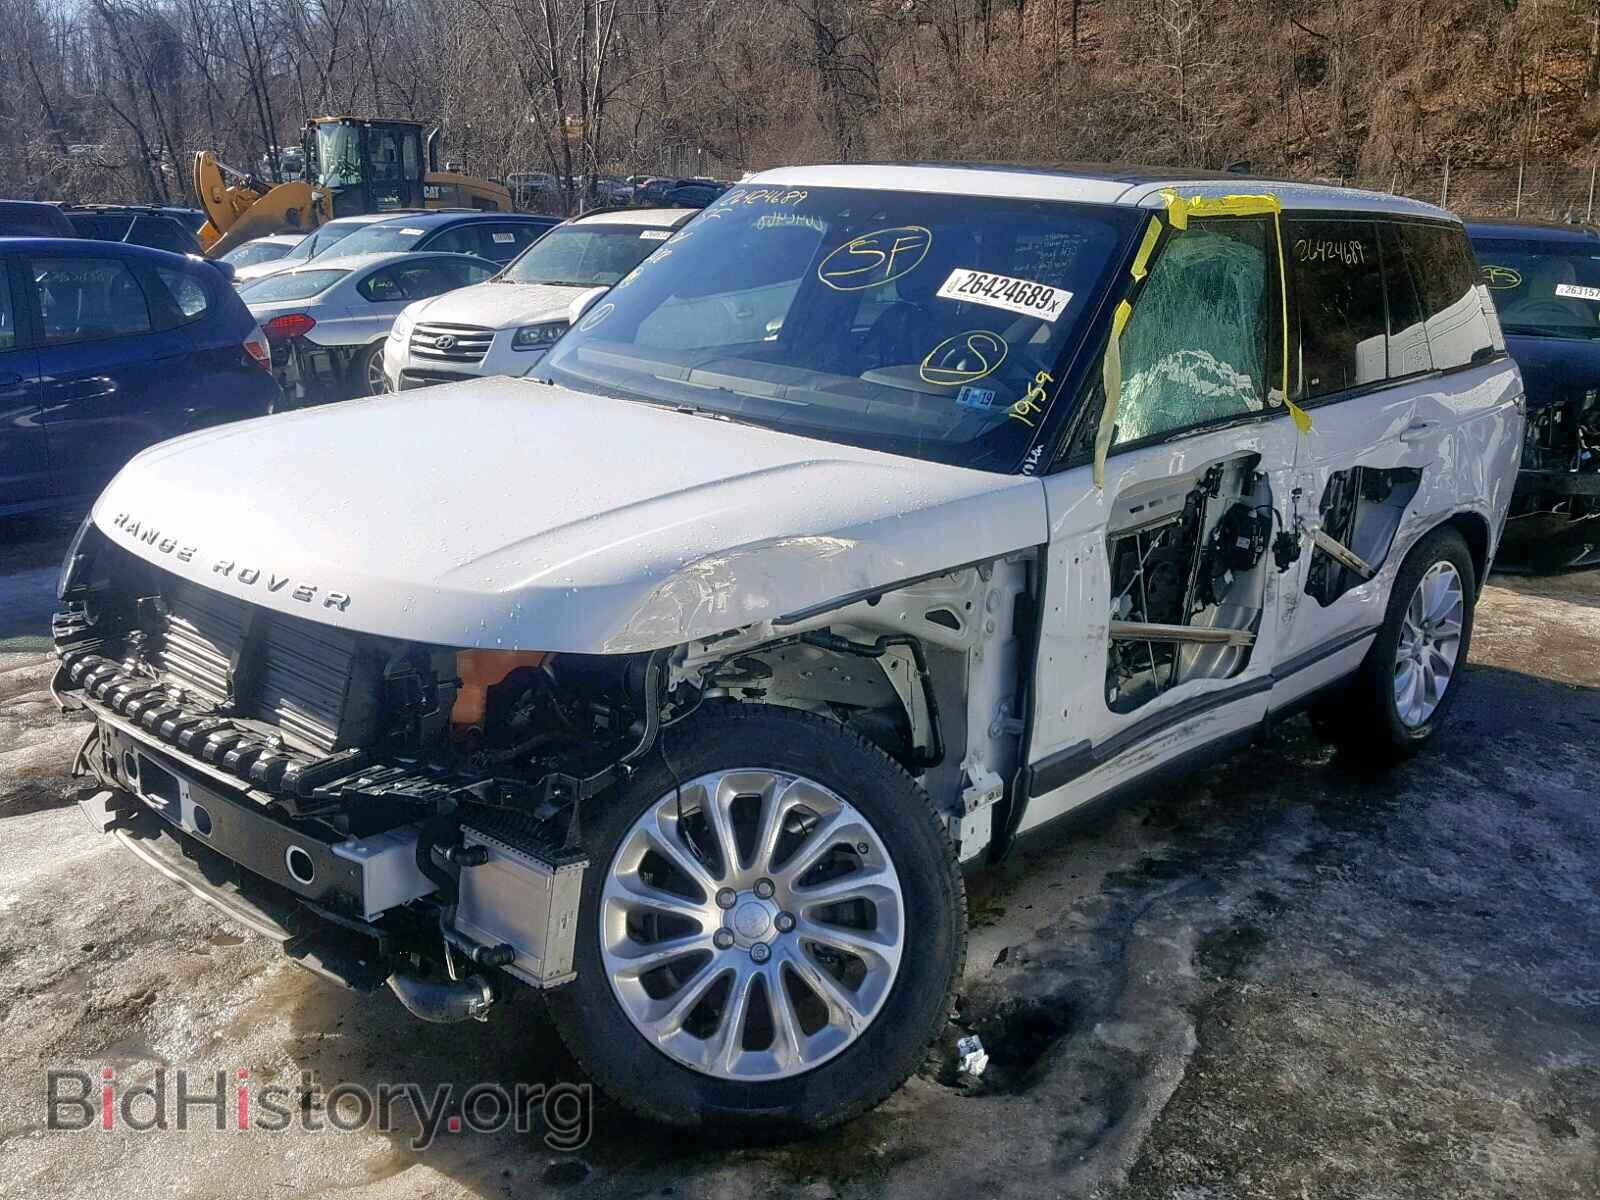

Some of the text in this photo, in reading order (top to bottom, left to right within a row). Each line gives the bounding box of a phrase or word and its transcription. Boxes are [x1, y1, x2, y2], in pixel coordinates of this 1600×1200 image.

[424, 186, 439, 199] CAT
[824, 235, 925, 277] SF
[113, 513, 352, 612] RANGE ROVER
